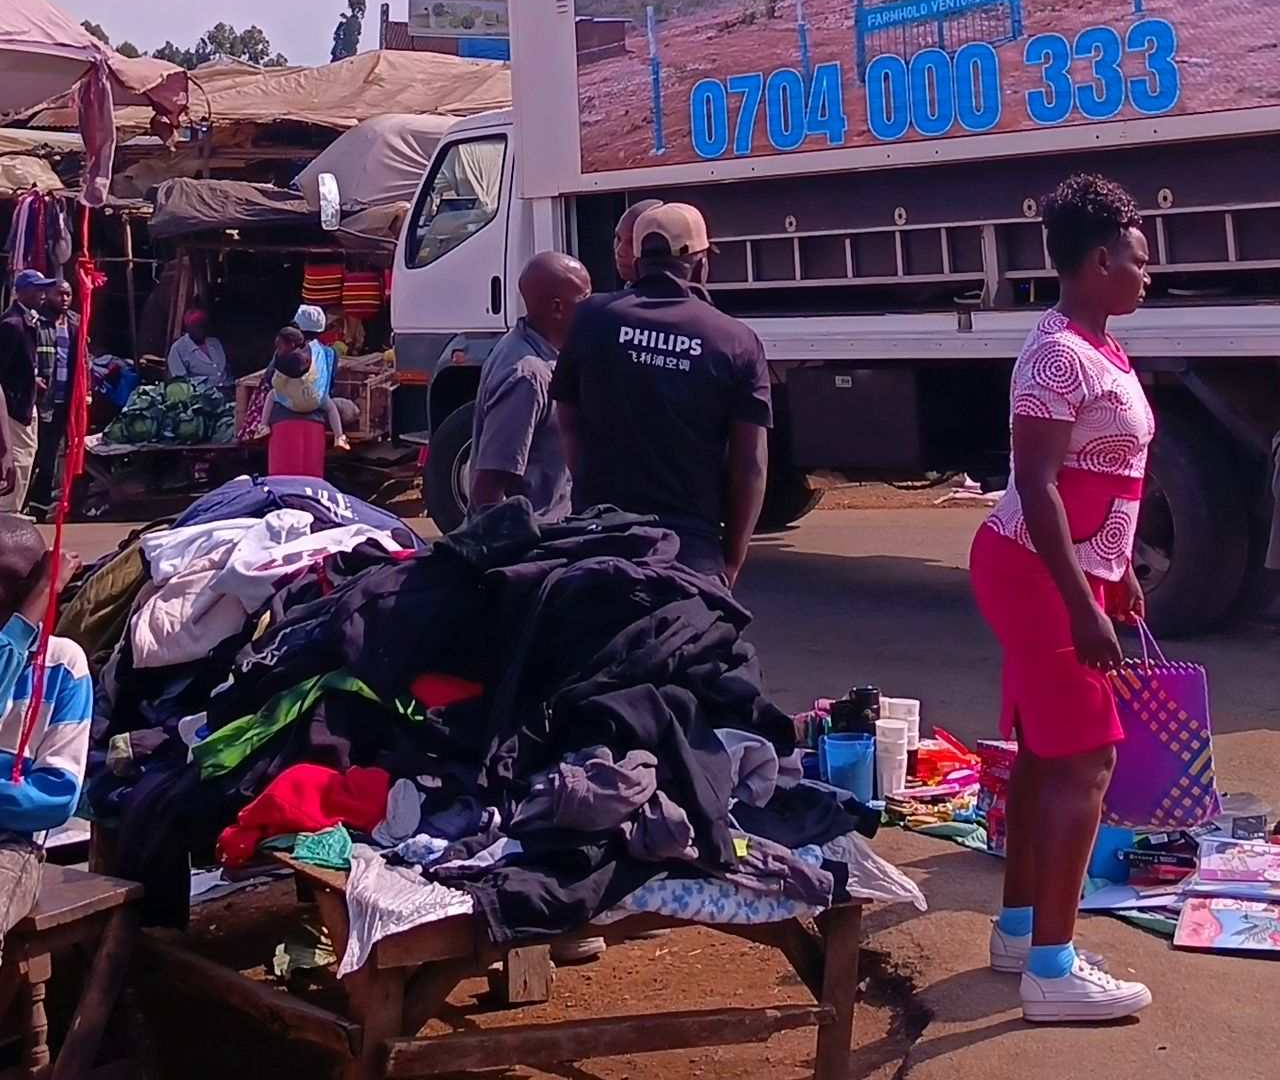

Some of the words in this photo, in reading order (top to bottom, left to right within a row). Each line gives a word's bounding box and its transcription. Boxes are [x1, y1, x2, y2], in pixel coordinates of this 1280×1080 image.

[867, 2, 928, 28] FARMHOLD
[690, 61, 847, 159] 0704
[865, 41, 1001, 141] 000
[1024, 18, 1180, 125] 333
[618, 326, 702, 356] PHILIPS
